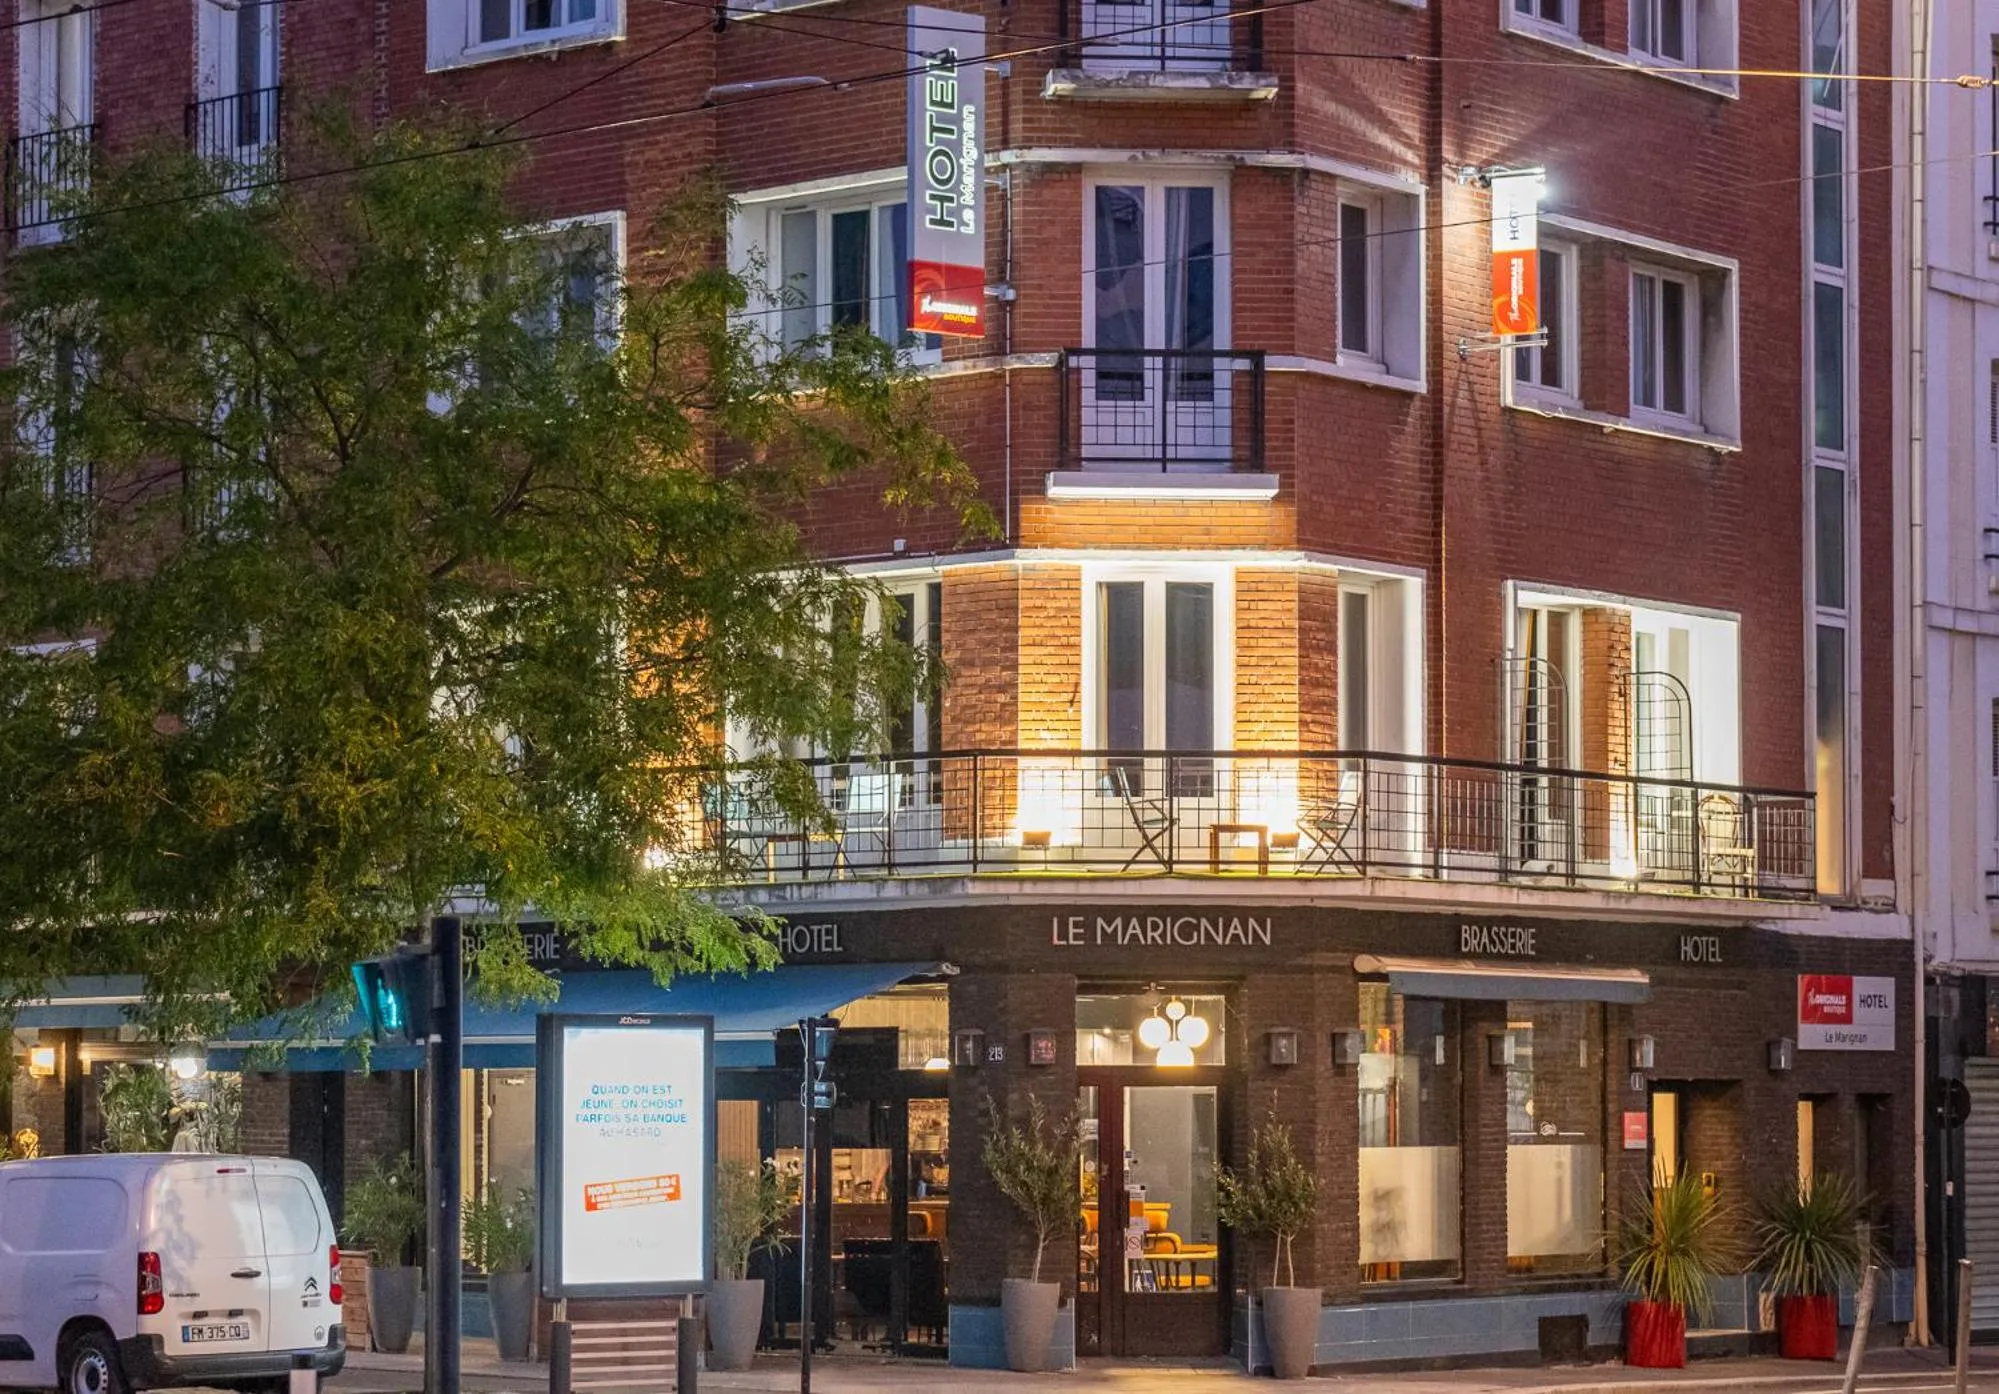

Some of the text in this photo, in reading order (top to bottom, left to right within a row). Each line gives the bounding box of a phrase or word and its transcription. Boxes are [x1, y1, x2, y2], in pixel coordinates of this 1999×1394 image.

[925, 47, 958, 231] HOTEL
[960, 104, 979, 235] Le Marignan
[778, 924, 843, 954] HOTEL
[1052, 916, 1272, 946] LE MARIGNAN
[1461, 924, 1537, 956] BRASSERIE
[1680, 935, 1723, 963] HOTEL
[1859, 994, 1888, 1009] HOTEL
[1825, 1031, 1868, 1046] Le Marignan
[988, 1046, 1003, 1061] 213
[591, 1084, 672, 1095] QUAND ON EST
[621, 1098, 638, 1109] ON
[641, 1098, 683, 1109] CHOISIT
[624, 1113, 640, 1123] SA
[643, 1113, 688, 1123] BANQUE
